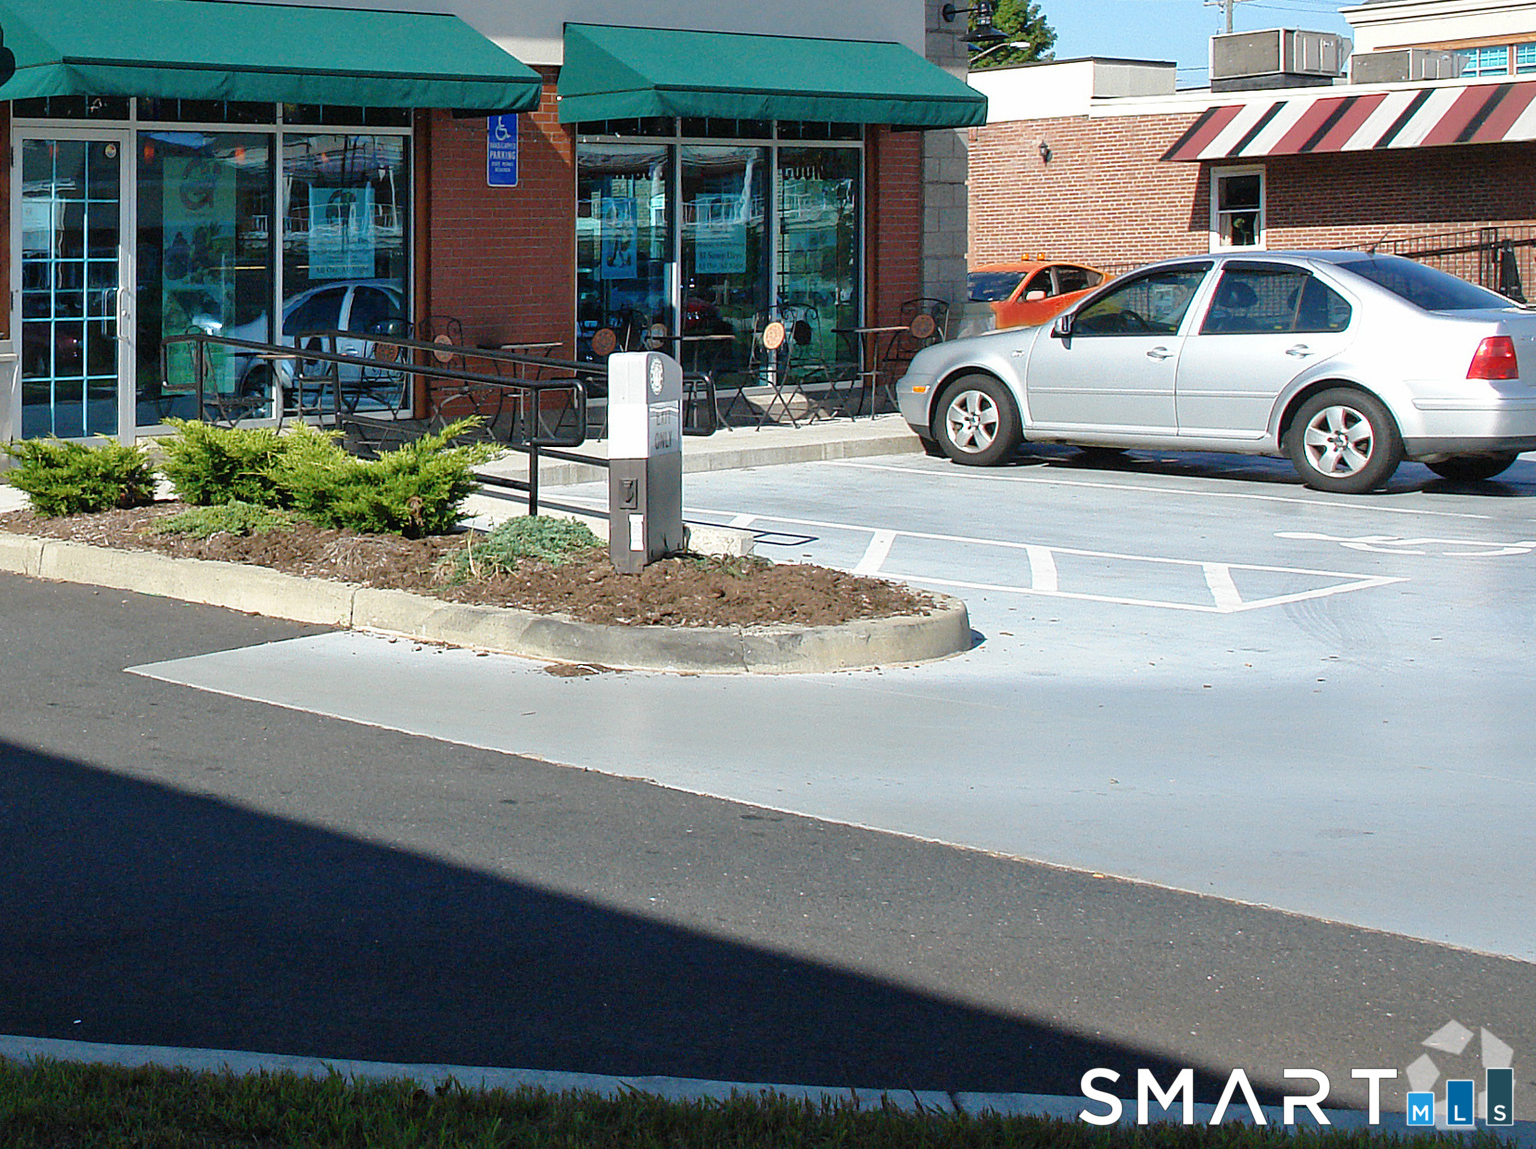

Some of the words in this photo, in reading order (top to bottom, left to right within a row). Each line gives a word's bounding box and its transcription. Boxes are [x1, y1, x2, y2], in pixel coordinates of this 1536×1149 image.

[489, 150, 516, 160] PARKING
[656, 411, 672, 426] EXIT
[654, 431, 672, 450] ONLY
